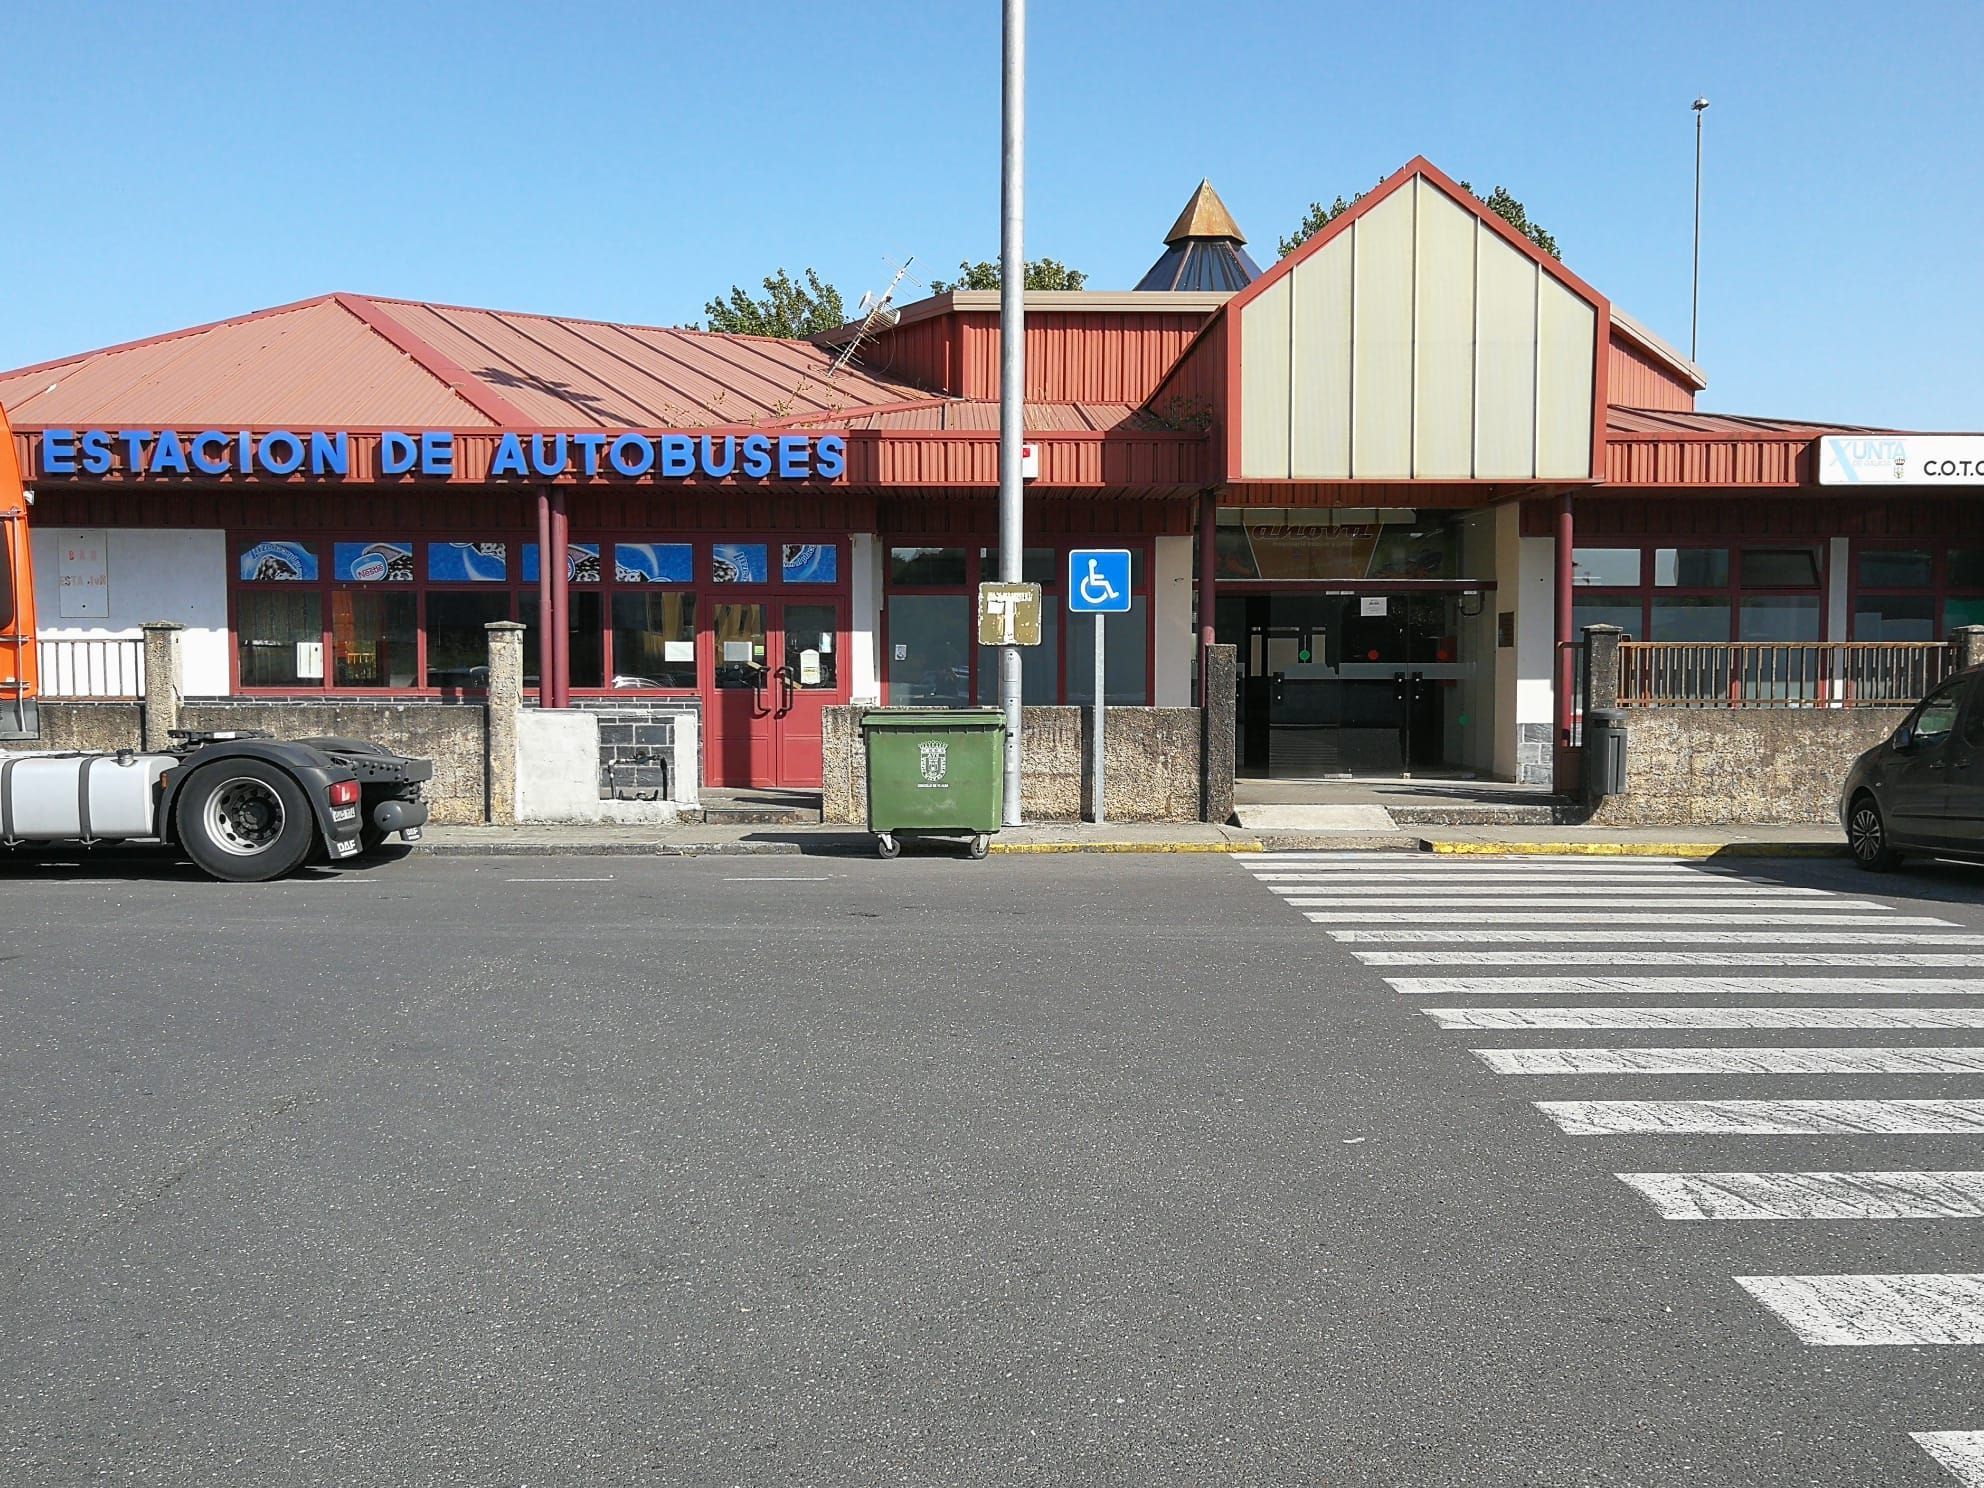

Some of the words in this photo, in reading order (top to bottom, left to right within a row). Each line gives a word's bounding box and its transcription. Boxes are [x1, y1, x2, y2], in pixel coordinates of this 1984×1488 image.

[43, 429, 349, 475] ESTACION
[382, 432, 453, 475] DE
[492, 433, 846, 479] AUTOBUSES
[1828, 439, 1907, 481] XUNTA
[405, 827, 419, 836] DAF
[337, 840, 356, 853] DAF
